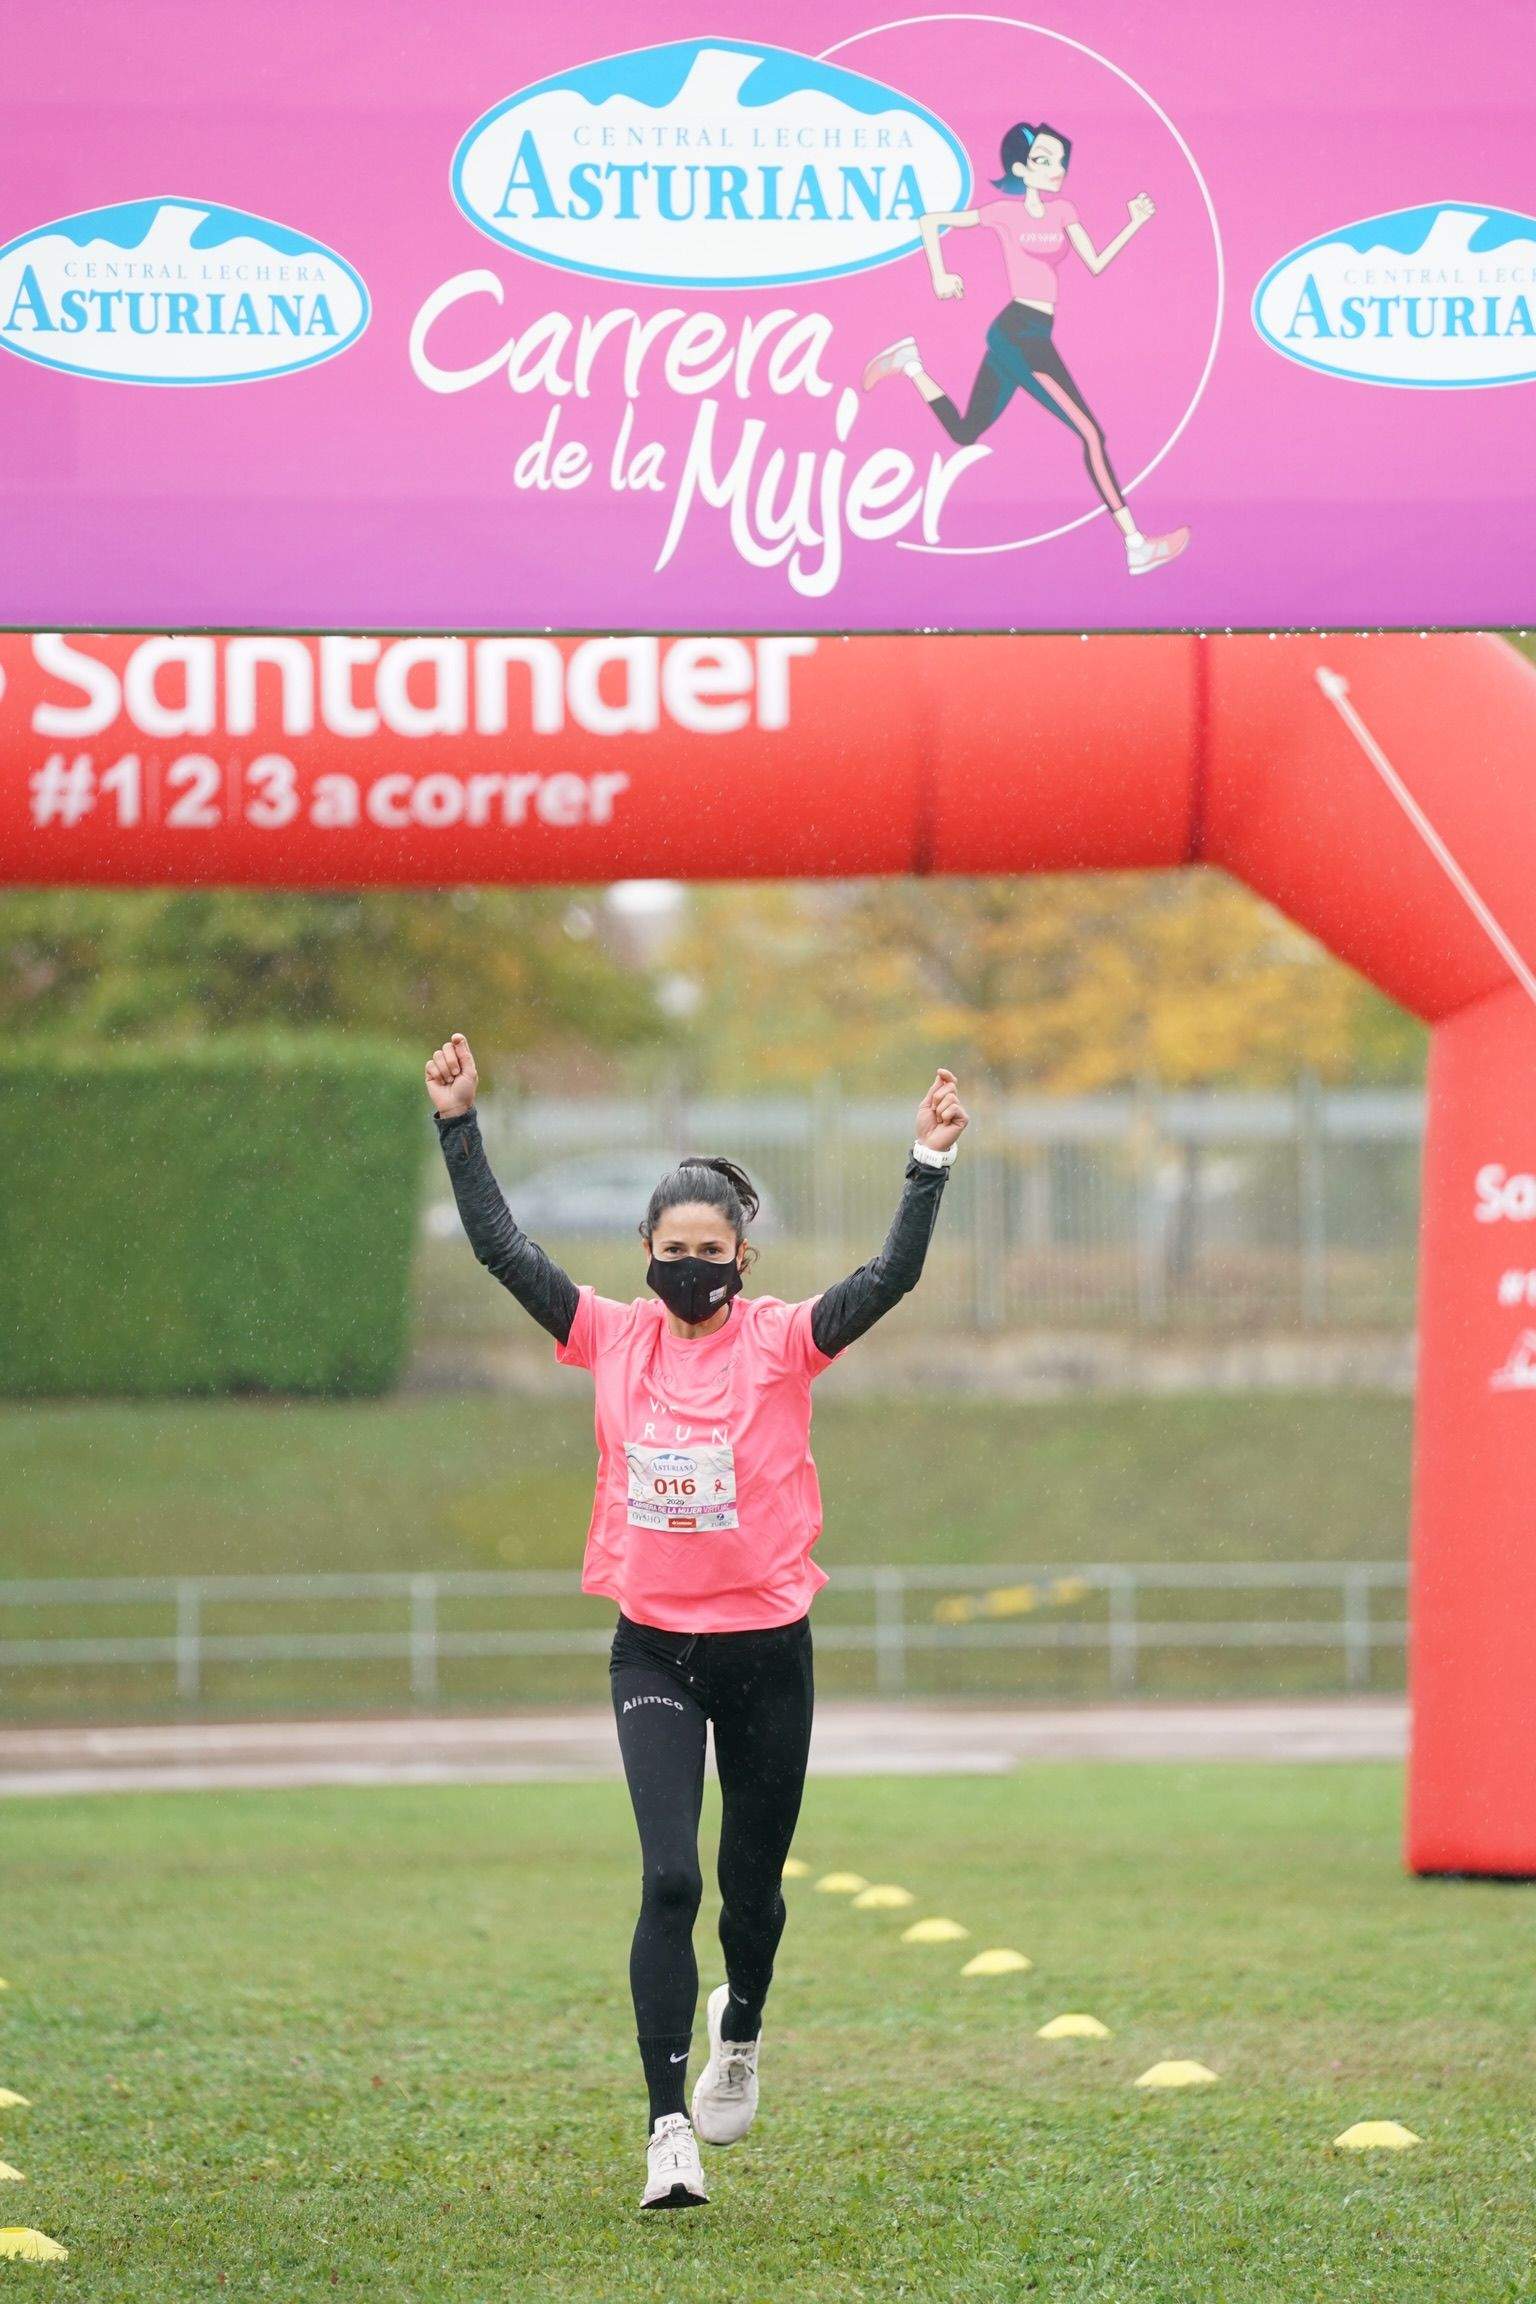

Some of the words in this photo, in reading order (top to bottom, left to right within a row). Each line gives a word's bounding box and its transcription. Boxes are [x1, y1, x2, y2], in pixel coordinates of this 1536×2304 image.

[573, 125, 734, 147] CENTRAL
[752, 127, 914, 148] LECHERA
[493, 129, 928, 221] ASTURIANA
[64, 261, 188, 279] CENTRAL
[201, 263, 327, 282] LECHERA
[1343, 268, 1465, 285] CENTRAL
[2, 264, 340, 337] ASTURIANA
[409, 269, 835, 398] Carrera
[513, 403, 593, 490] de
[610, 401, 666, 491] la
[654, 386, 994, 598] Mujer
[31, 633, 818, 738] Santander
[365, 770, 631, 830] correr
[644, 1422, 728, 1445] RUN
[654, 1478, 696, 1495] 016
[677, 1506, 702, 1514] MUJER
[622, 1695, 684, 1714] Alimco
